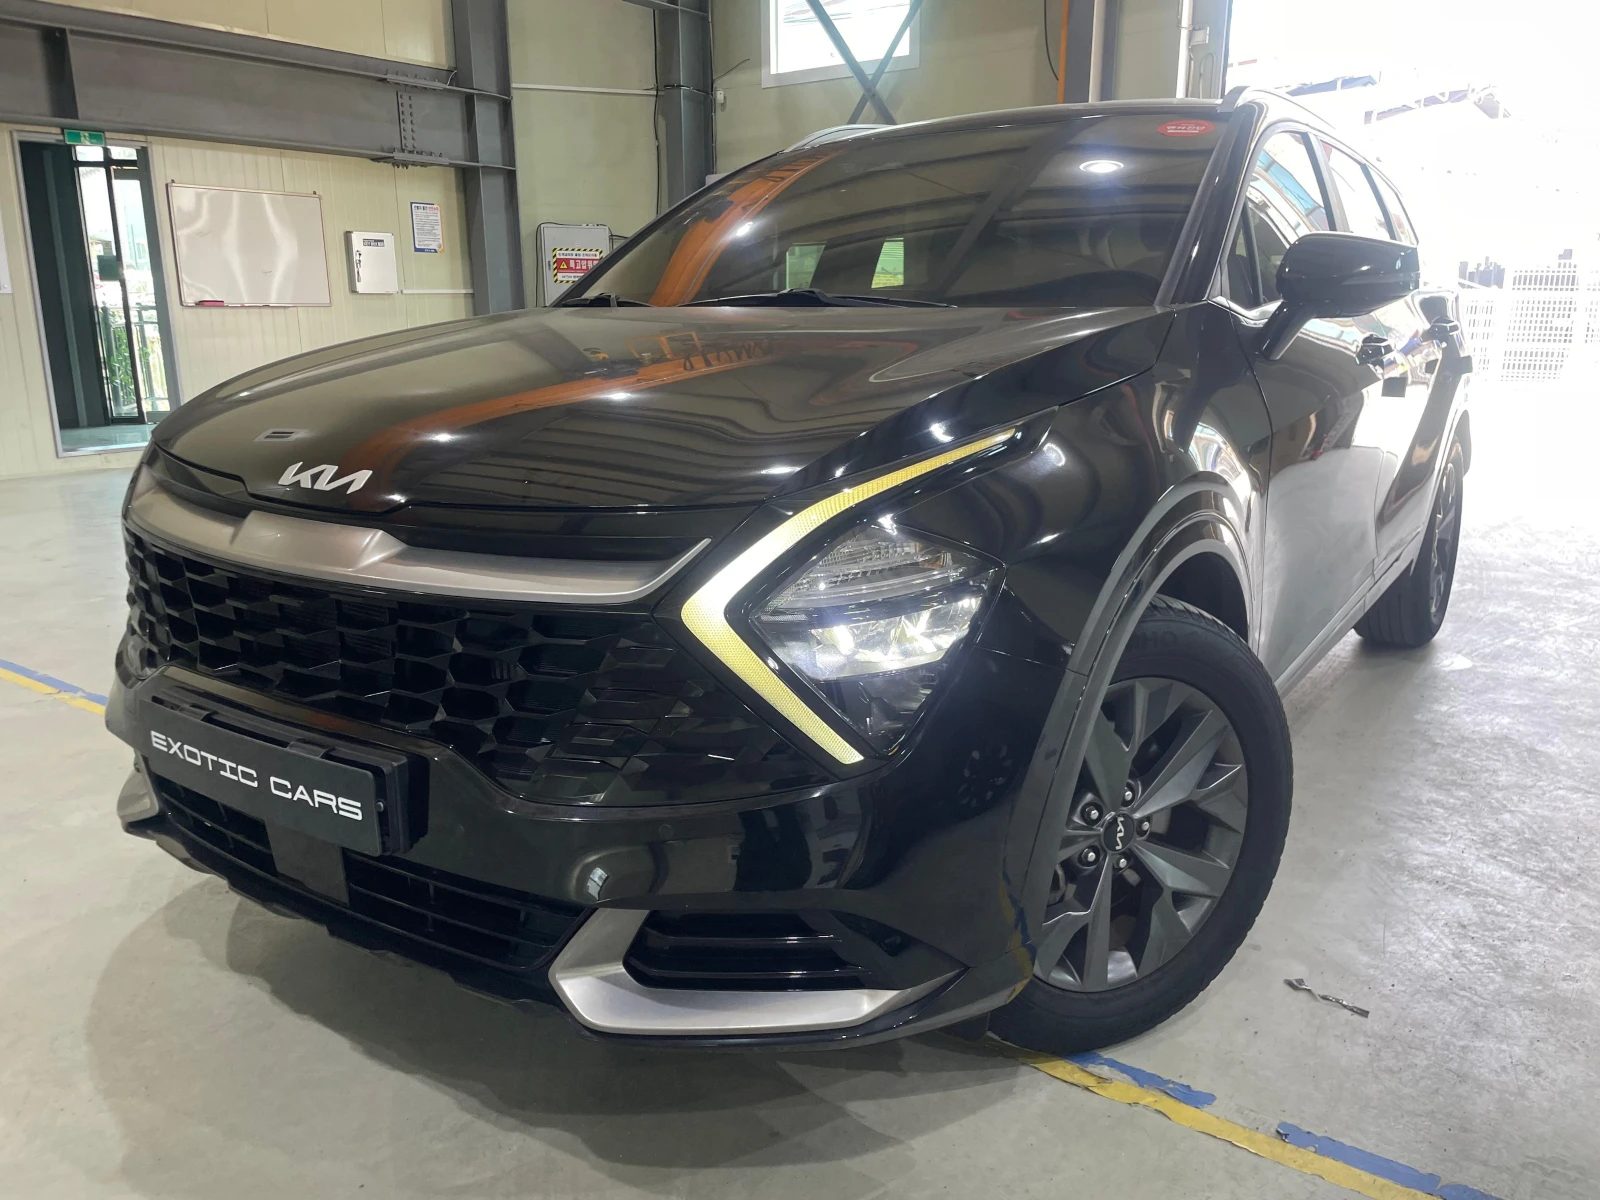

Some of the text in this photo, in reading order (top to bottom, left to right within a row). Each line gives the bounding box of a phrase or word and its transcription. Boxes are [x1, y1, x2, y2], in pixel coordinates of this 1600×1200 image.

[278, 461, 373, 494] KIA
[150, 730, 363, 821] EXOTIC CARS
